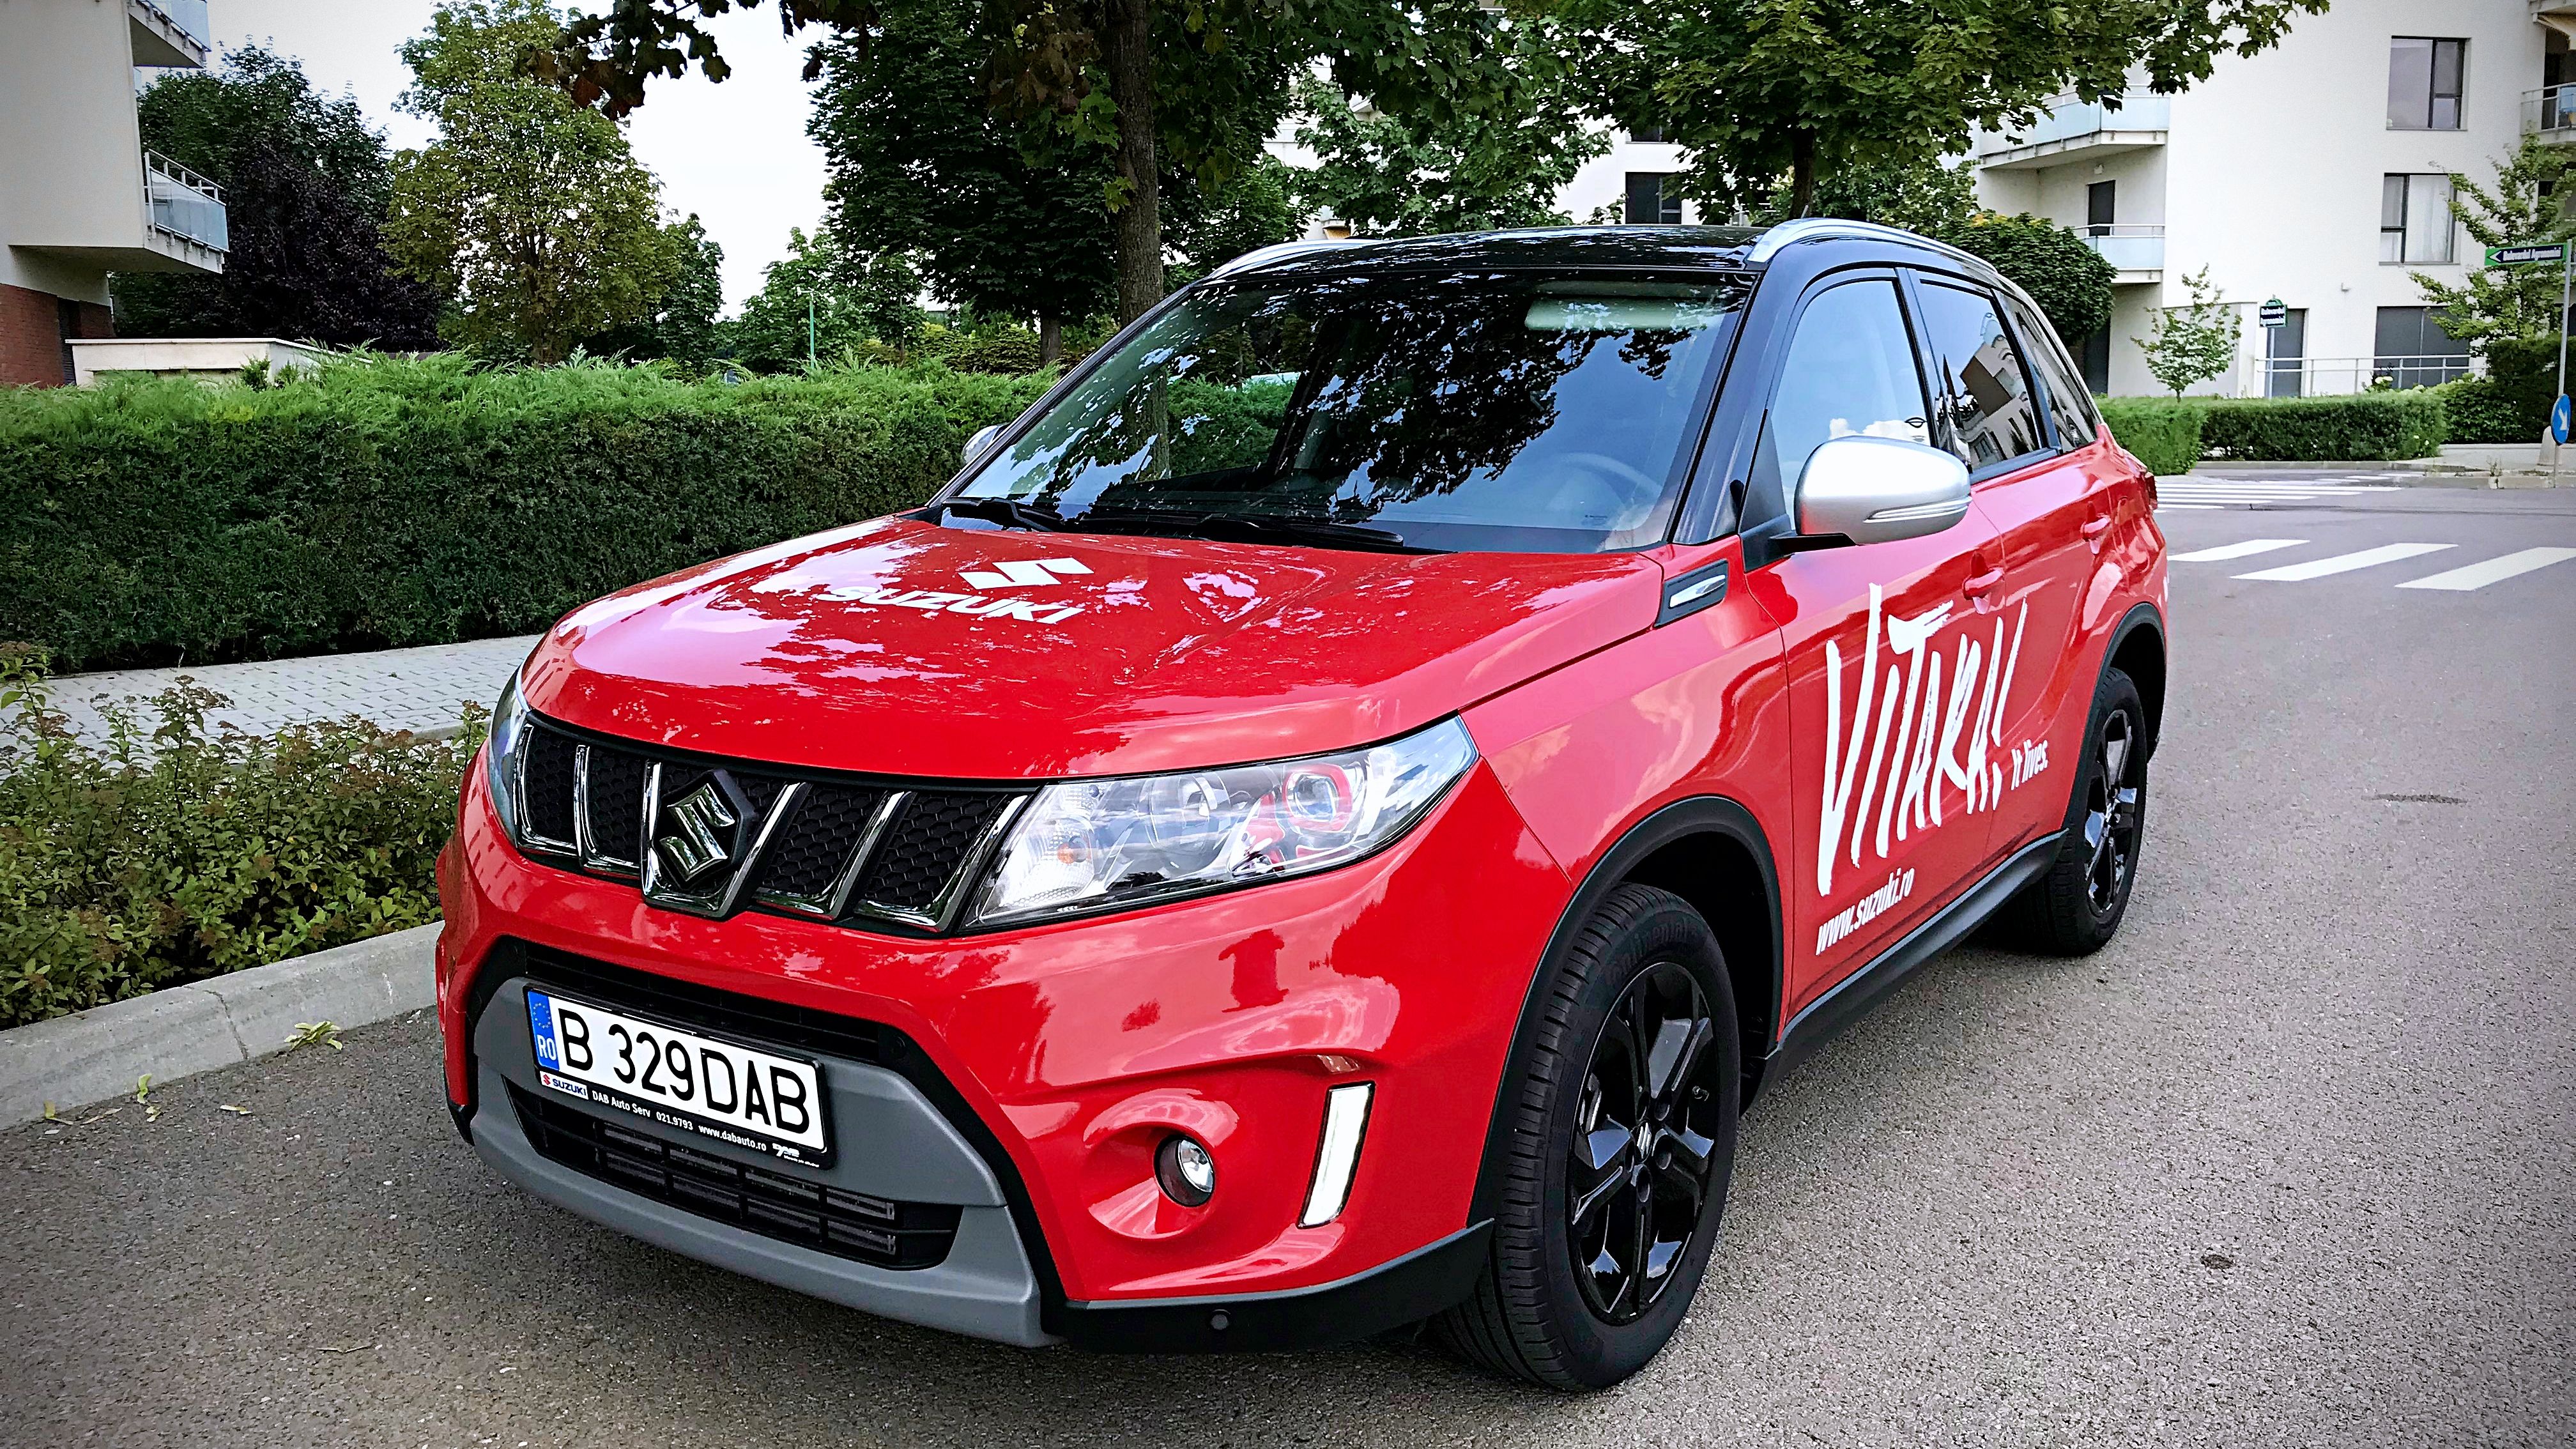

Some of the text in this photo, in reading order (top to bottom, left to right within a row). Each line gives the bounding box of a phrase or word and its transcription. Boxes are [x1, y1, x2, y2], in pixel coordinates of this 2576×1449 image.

[816, 585, 1085, 625] SUZUKI
[2011, 739, 2049, 791] It lives.
[1815, 867, 1915, 956] www.suzuki.ro
[537, 1034, 557, 1062] RO
[558, 1008, 594, 1072] B
[552, 1078, 586, 1096] SUZUKI
[592, 1090, 767, 1151] DAB Auto Serv 021.9793 www.dabauto.ro
